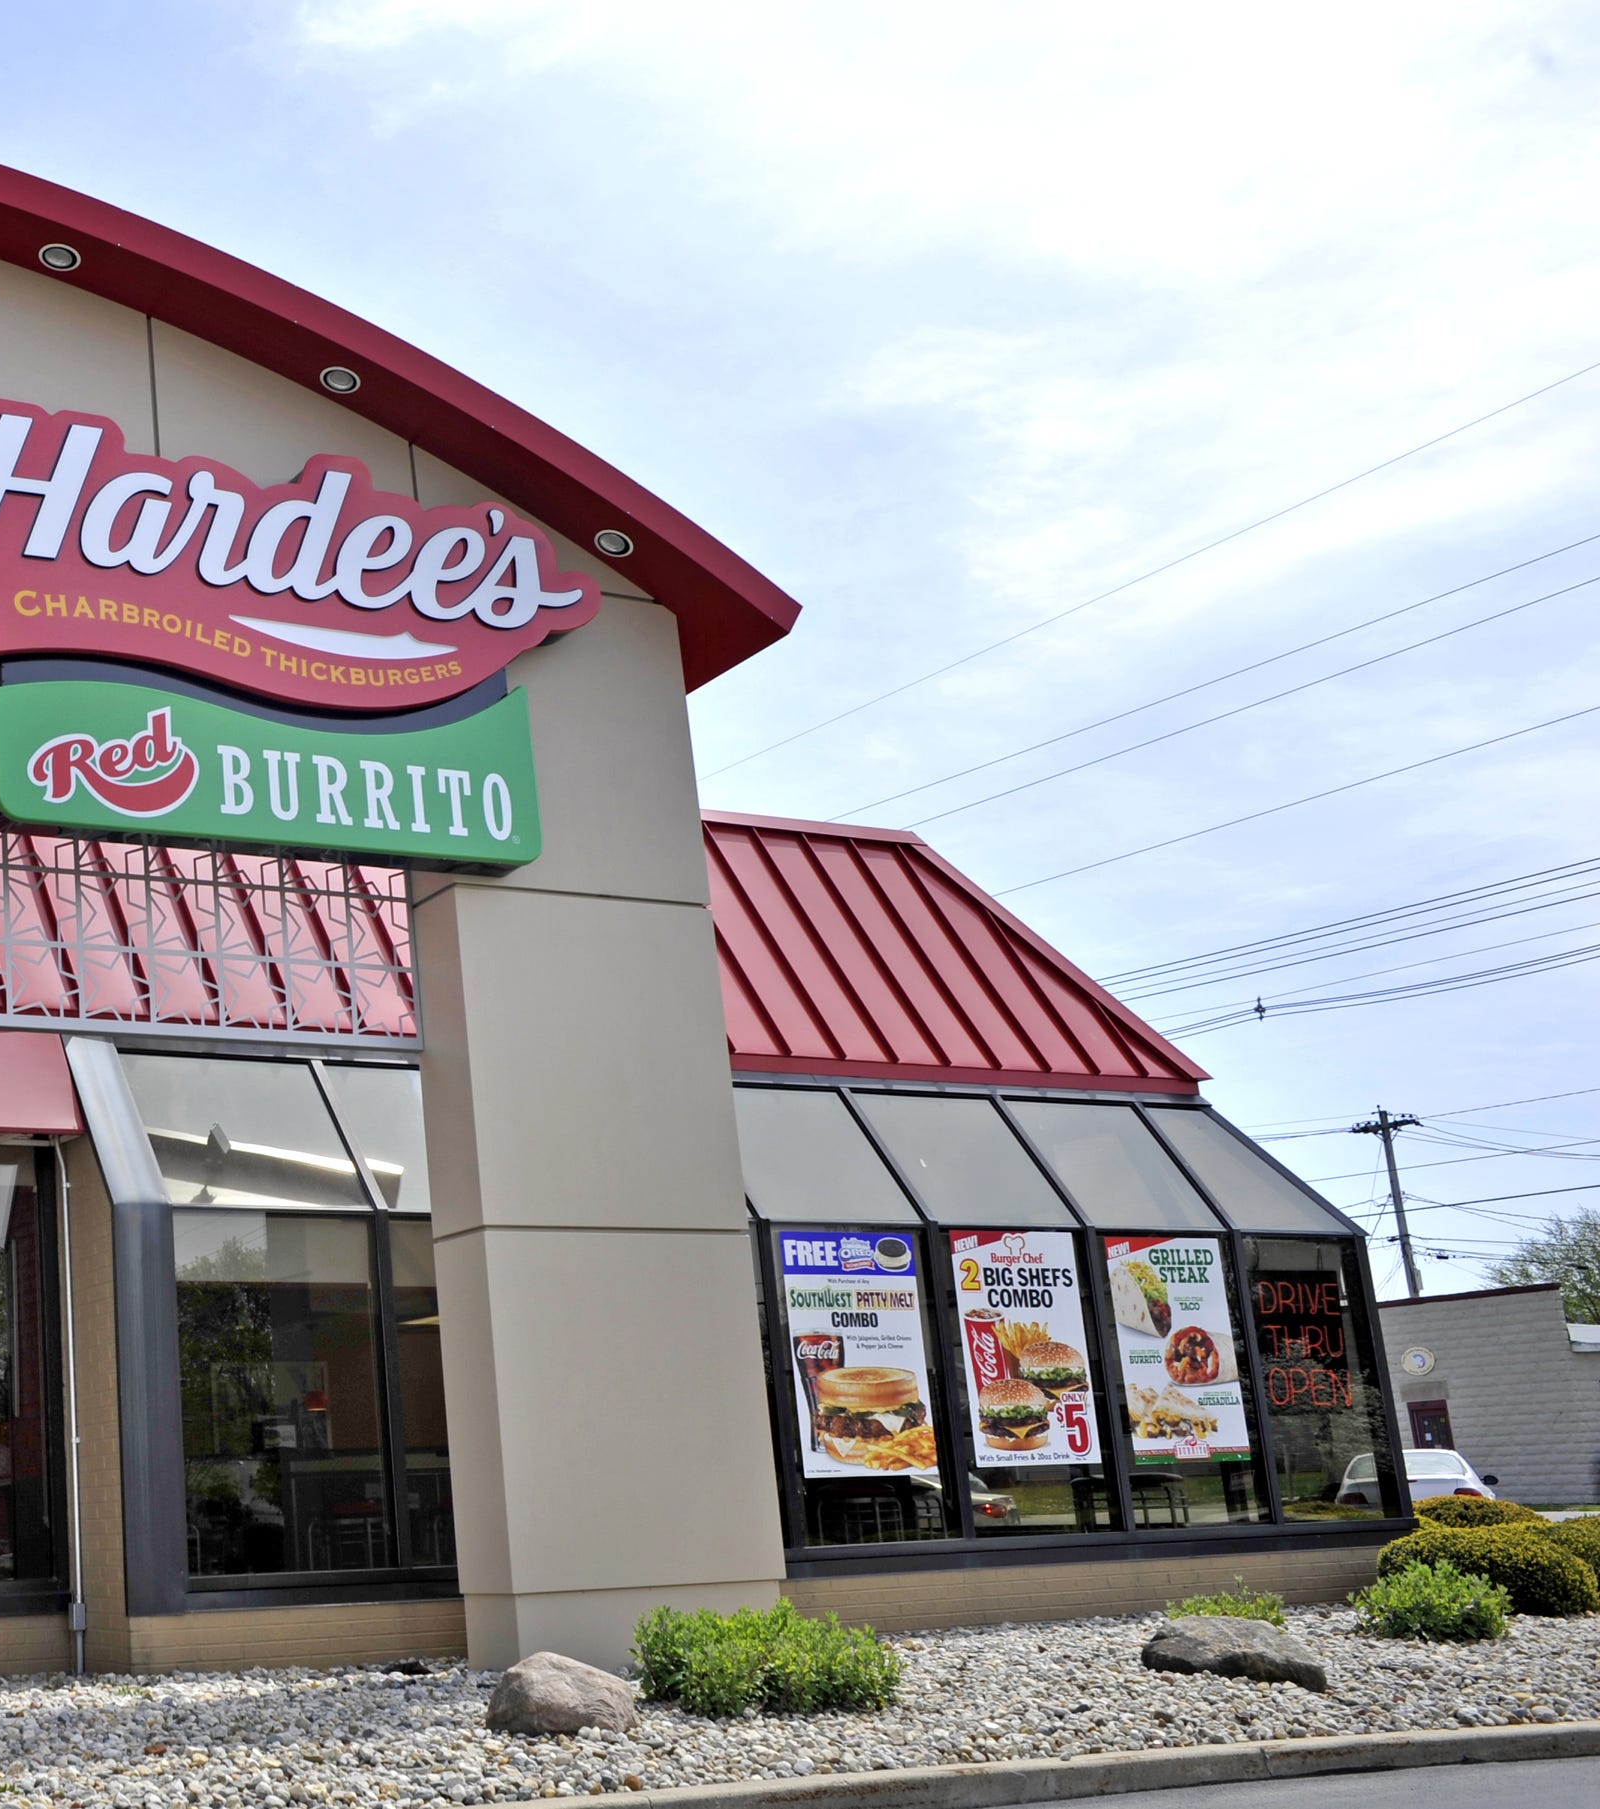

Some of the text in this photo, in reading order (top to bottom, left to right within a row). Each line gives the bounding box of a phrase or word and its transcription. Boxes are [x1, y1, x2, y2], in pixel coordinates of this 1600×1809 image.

[13, 589, 463, 688] CHARBROILED THICKBURGERS
[28, 706, 513, 842] Red BURRITO
[953, 1234, 979, 1253] NEW!
[1107, 1241, 1131, 1259] NEW!
[783, 1239, 839, 1267] FREE
[840, 1247, 872, 1259] OREO
[990, 1252, 1044, 1267] Burger Chef
[1148, 1248, 1214, 1266] GRILLED
[959, 1258, 1073, 1291] 2 BIG SHEFS
[1159, 1266, 1210, 1284] STEAK
[856, 1291, 887, 1309] PATTY
[889, 1292, 914, 1309] MELT
[987, 1288, 1054, 1308] COMBO
[1179, 1301, 1201, 1311] TACO
[1258, 1281, 1341, 1316] DRIVE
[831, 1311, 879, 1328] COMBO
[1263, 1325, 1345, 1359] THRU
[1129, 1355, 1162, 1365] BURRITO
[1268, 1367, 1353, 1407] OPEN
[1061, 1392, 1084, 1403] ONLY
[1197, 1396, 1241, 1406] QUESADILLA
[979, 1454, 995, 1462] With
[995, 1454, 1013, 1462] Small
[1013, 1453, 1029, 1461] Fries
[1030, 1453, 1036, 1461] &
[1053, 1452, 1070, 1460] Drink
